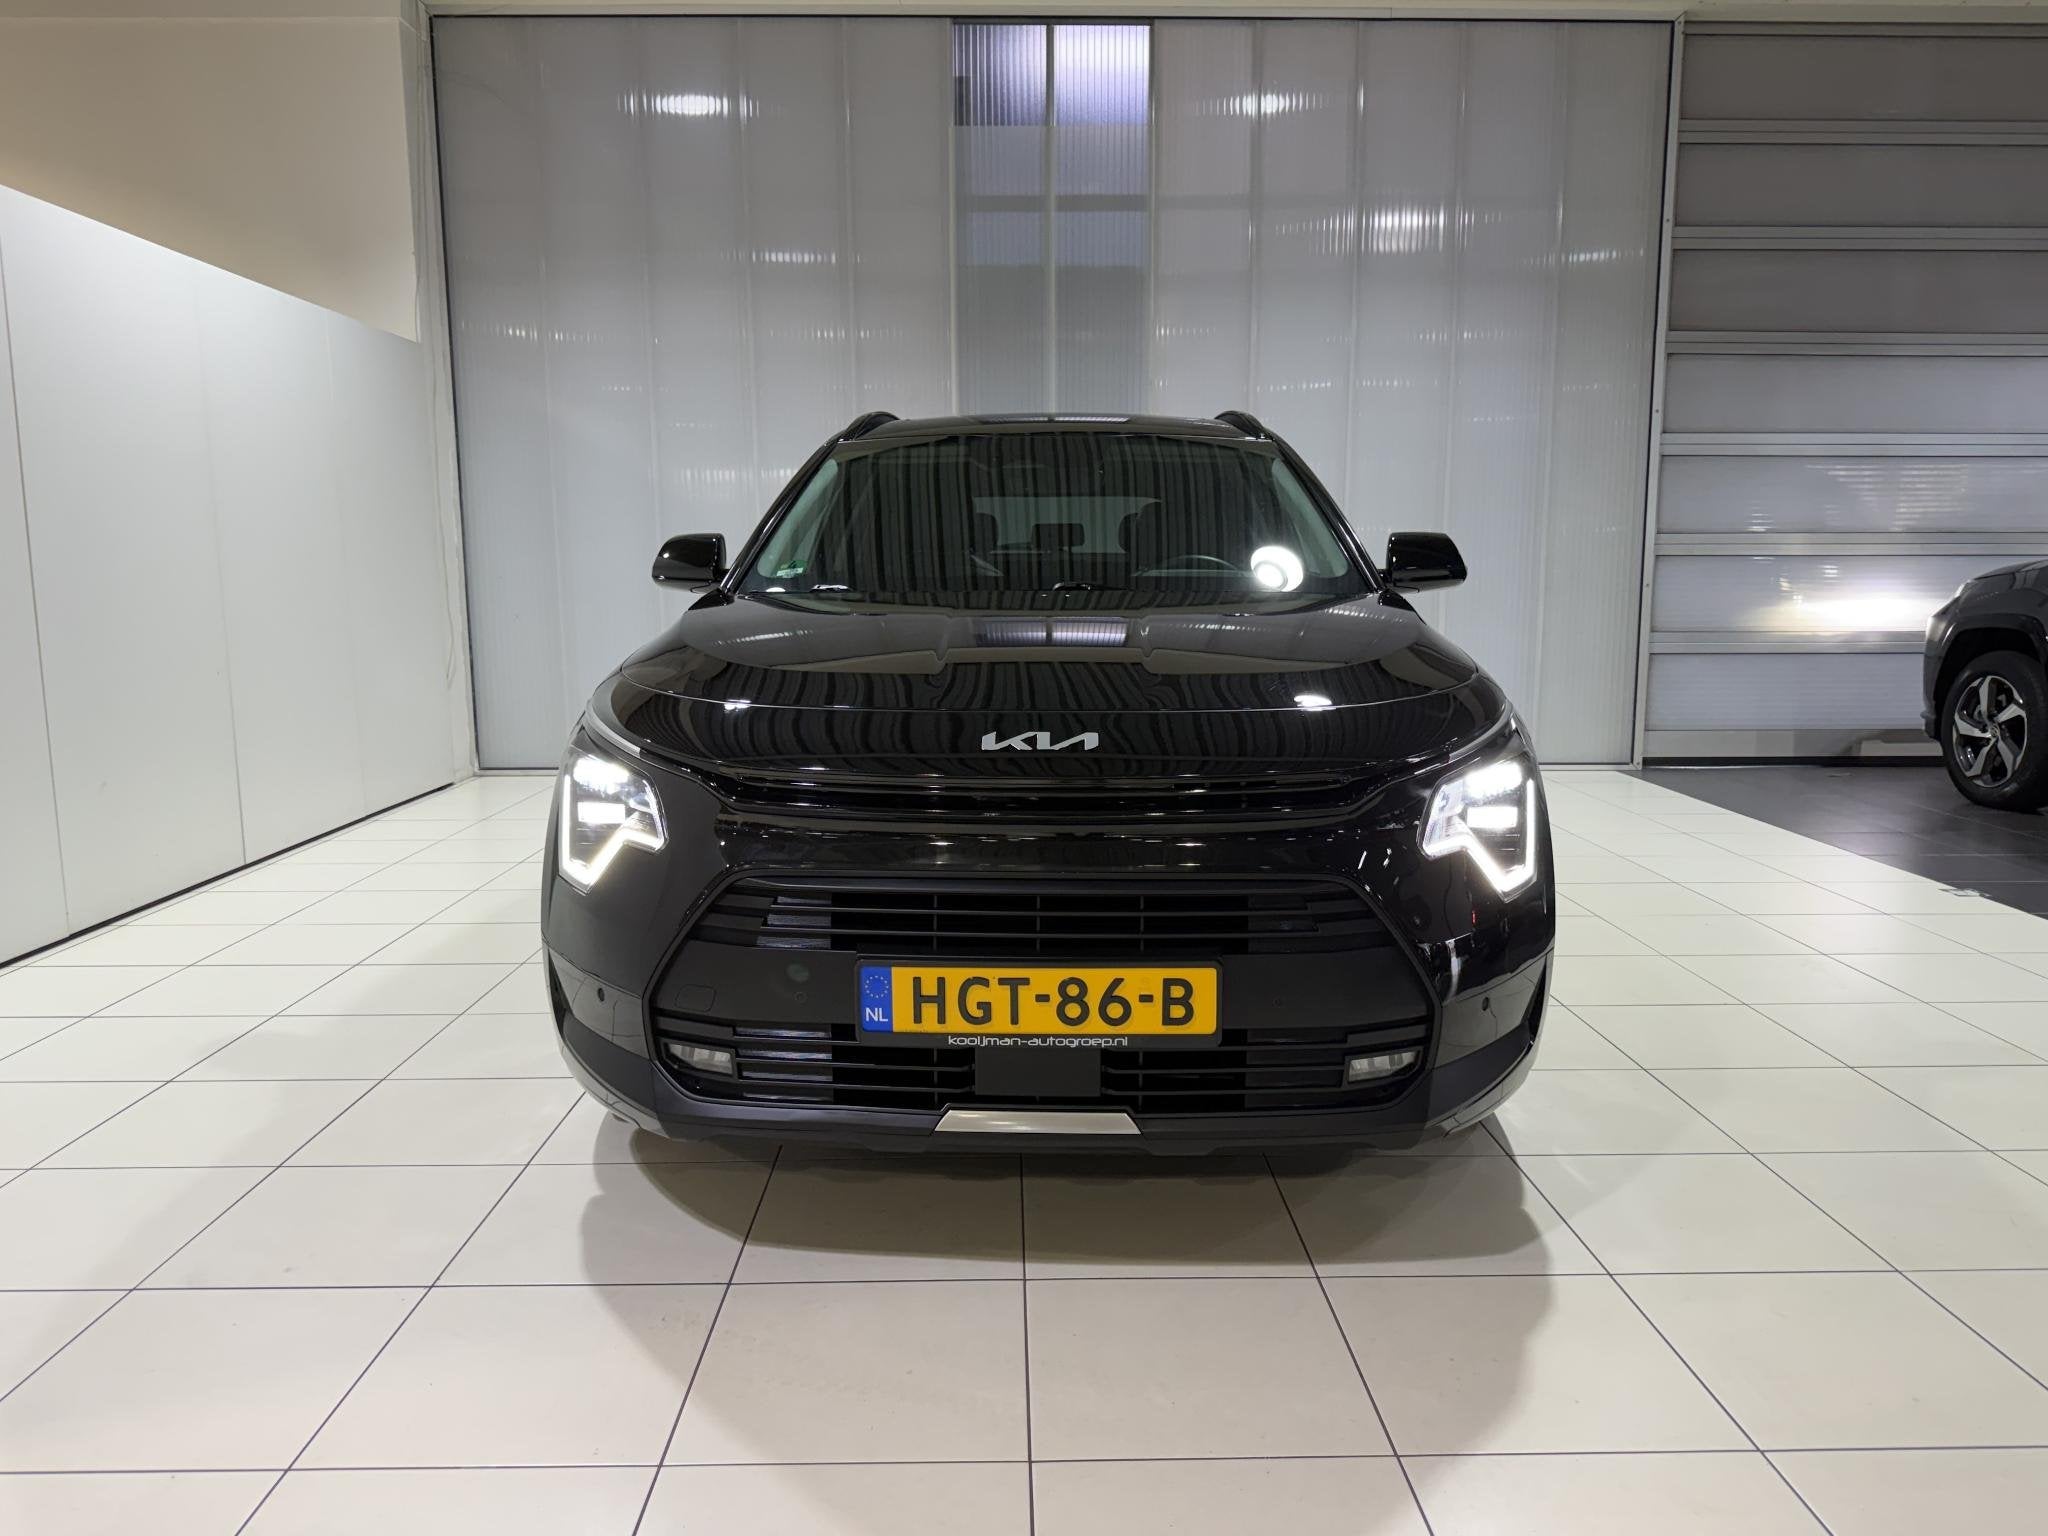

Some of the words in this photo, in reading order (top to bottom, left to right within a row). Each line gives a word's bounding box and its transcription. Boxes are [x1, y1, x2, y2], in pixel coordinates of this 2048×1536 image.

[981, 731, 1099, 751] KIA
[912, 976, 1194, 1026] HGT-86-B
[865, 1007, 889, 1022] NL
[948, 1035, 1128, 1048] kooijman-autogroep.nl
